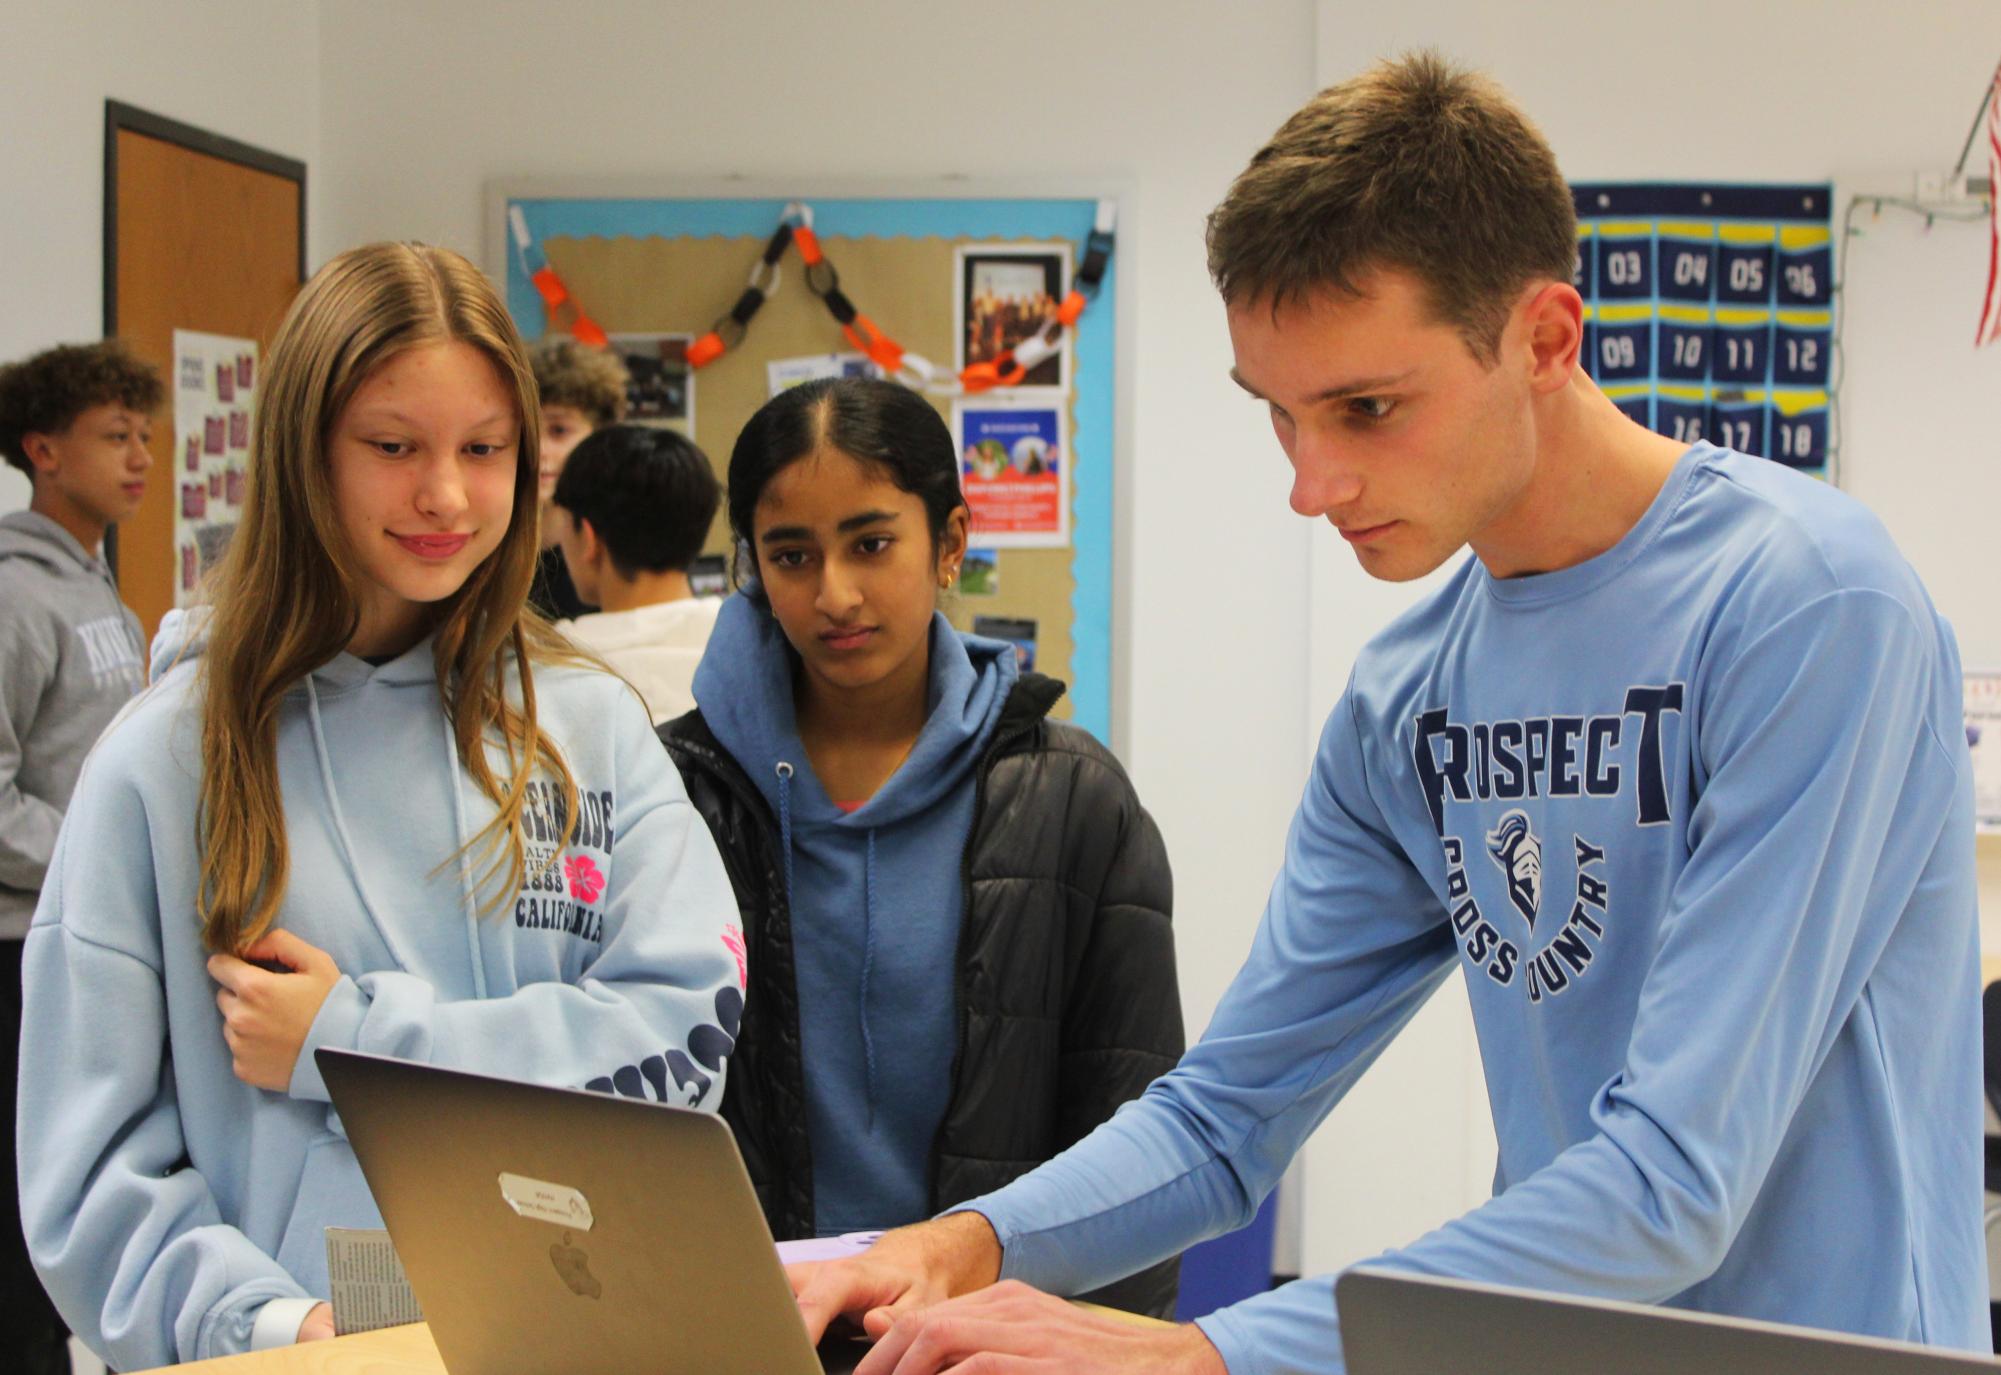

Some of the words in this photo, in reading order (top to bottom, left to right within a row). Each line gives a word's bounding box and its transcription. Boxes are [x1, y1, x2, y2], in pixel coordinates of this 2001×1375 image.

[1607, 252, 1642, 285] 03
[1674, 252, 1709, 287] 04
[1729, 258, 1764, 292] 05
[1601, 336, 1636, 369] 09
[1673, 334, 1703, 368] 10
[1726, 339, 1755, 371] 11
[1786, 339, 1818, 372] 12
[1721, 420, 1751, 453] 17
[1781, 423, 1813, 458] 18
[523, 859, 560, 874] IBES
[1525, 832, 1609, 1005] OUNTRY
